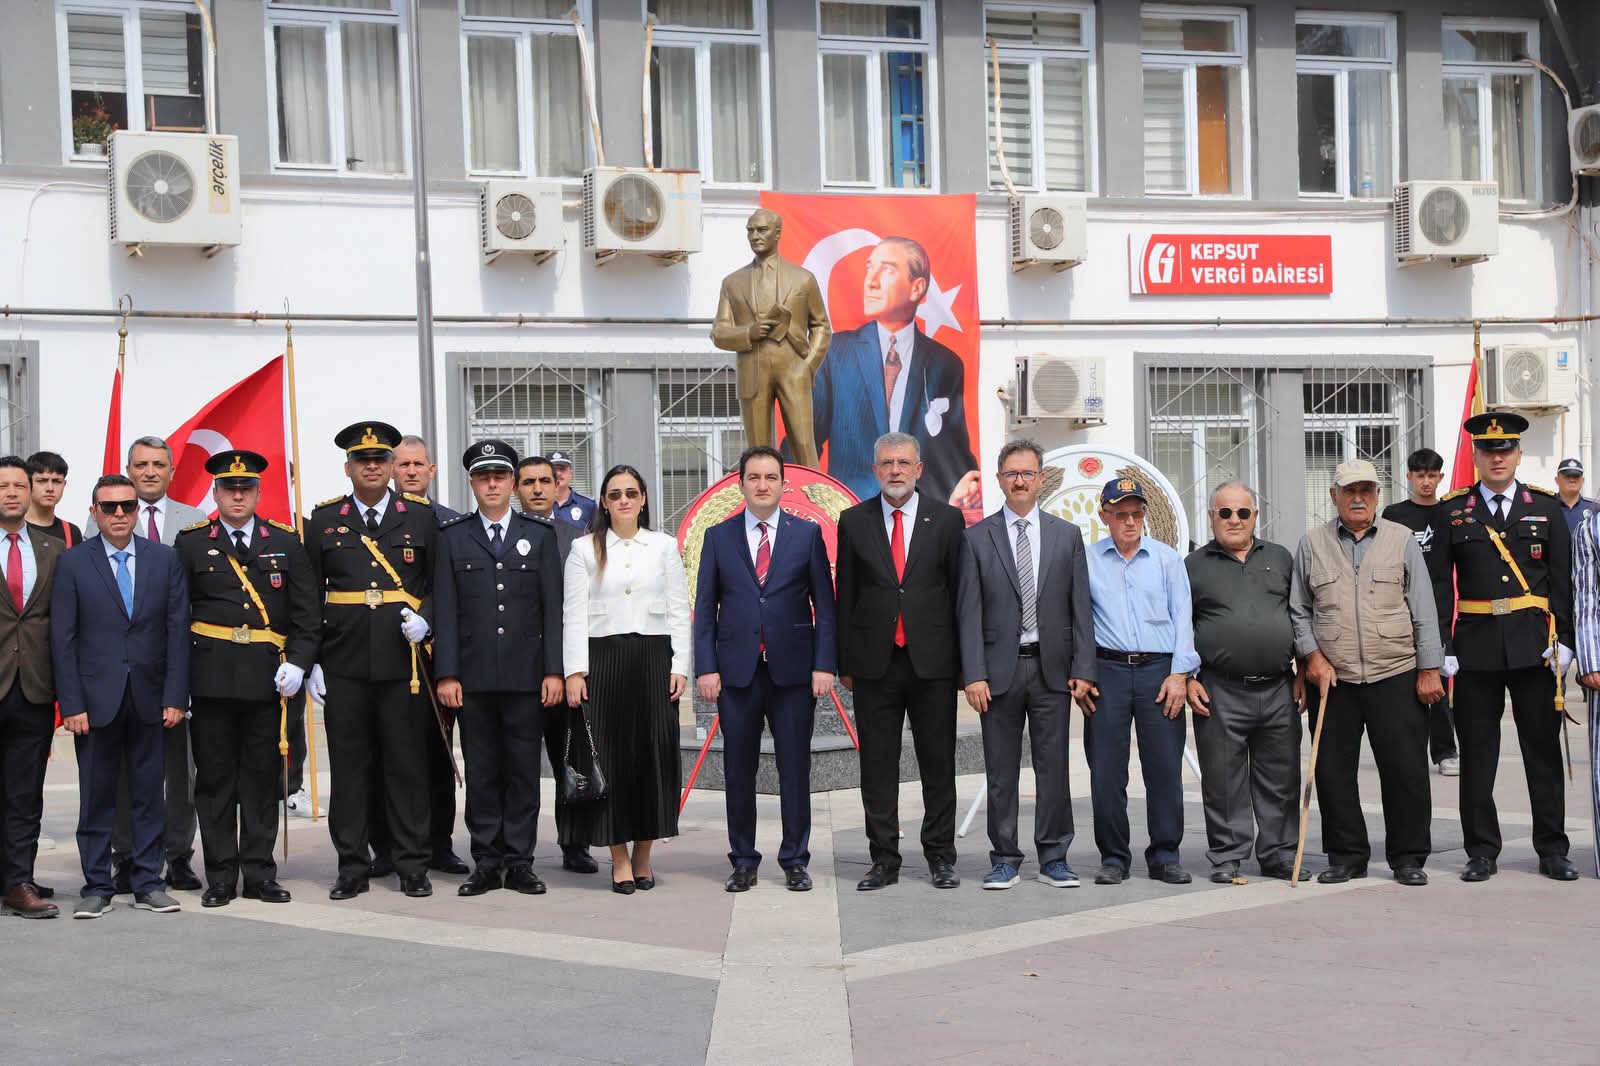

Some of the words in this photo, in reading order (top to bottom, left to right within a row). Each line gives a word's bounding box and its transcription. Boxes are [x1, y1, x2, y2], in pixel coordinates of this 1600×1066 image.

[209, 140, 227, 195] arçelik
[1190, 243, 1260, 261] KEPSUT
[1191, 262, 1247, 284] VERGİ
[1251, 262, 1325, 284] DAİRESİ
